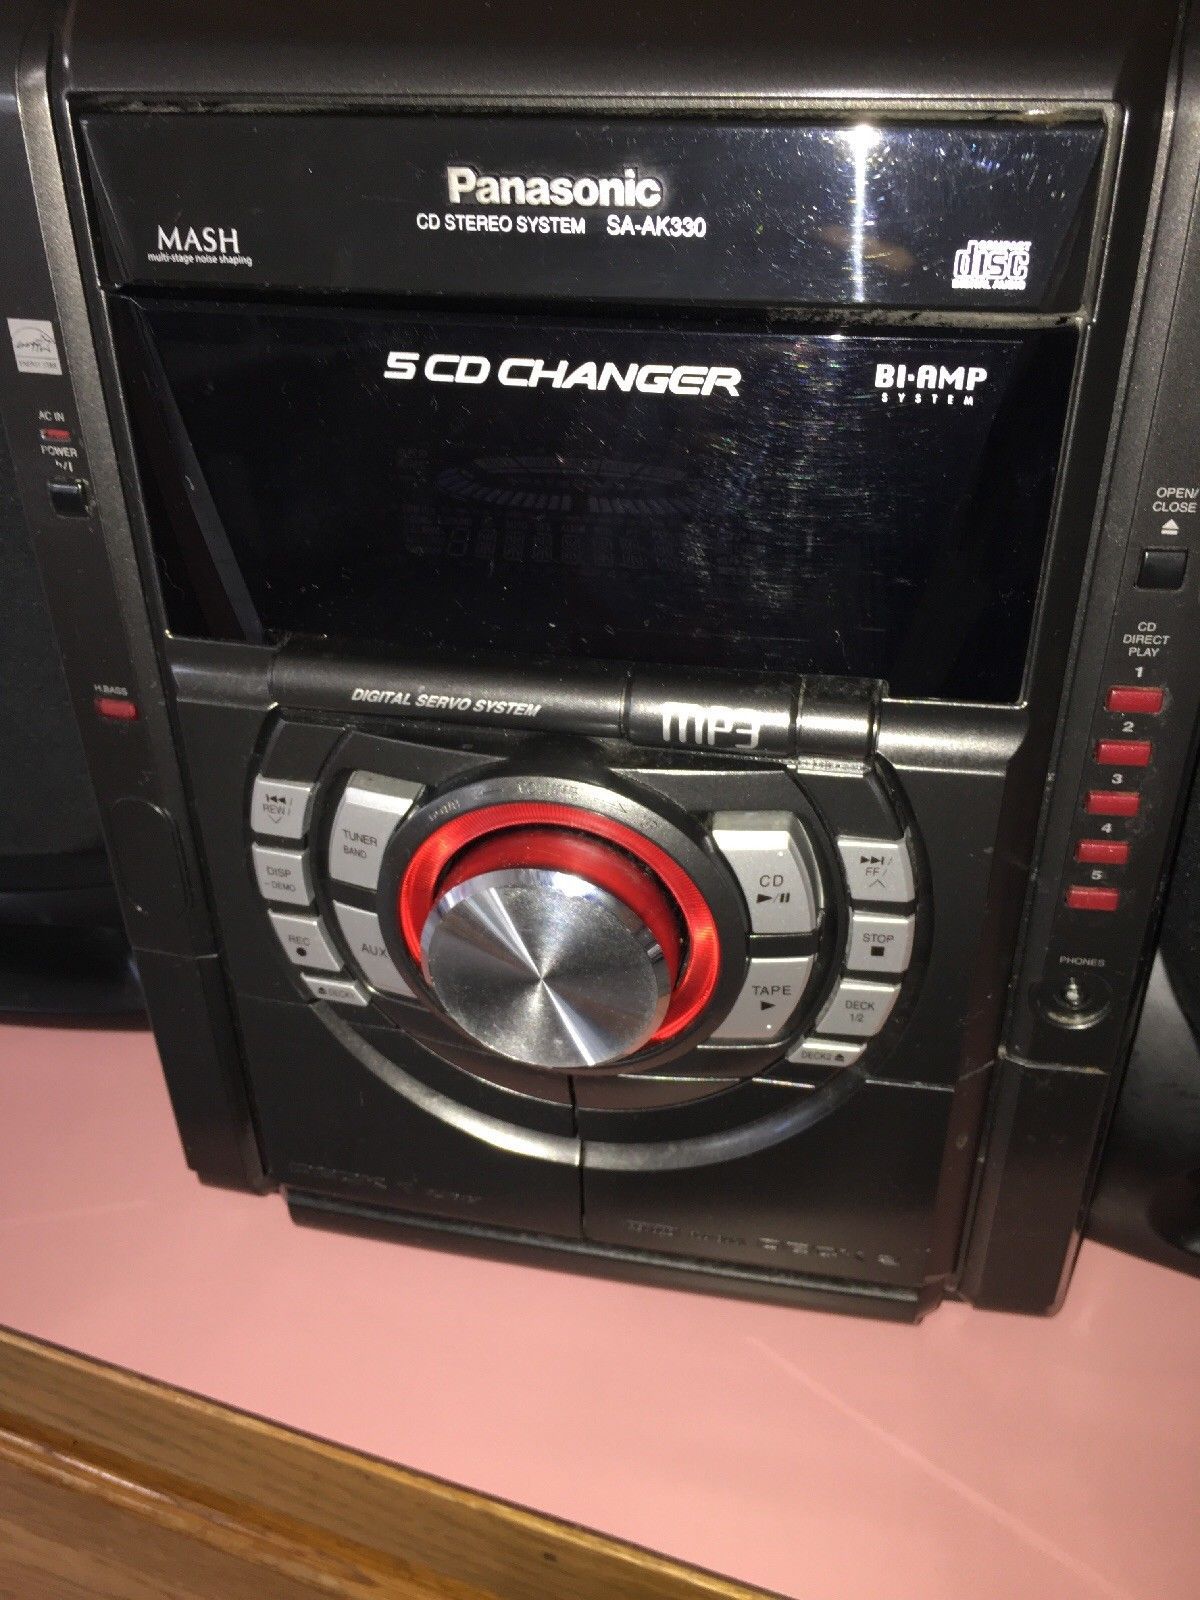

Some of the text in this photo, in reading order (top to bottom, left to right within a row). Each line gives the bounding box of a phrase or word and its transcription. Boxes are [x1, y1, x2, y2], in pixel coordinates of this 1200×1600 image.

[447, 165, 662, 208] Panasonic
[416, 213, 707, 238] CD STEREO SYSTEM SA-AK330
[158, 224, 240, 254] MASH
[147, 251, 253, 268] multi-stage noise shaping
[384, 351, 742, 397] 5 CD CHANGER
[881, 392, 974, 406] SYSTEM
[40, 444, 79, 458] POWER
[1152, 501, 1198, 513] CLOSE
[1137, 621, 1157, 632] CD
[1122, 634, 1171, 646] DIRECT
[1128, 647, 1161, 658] PLAY
[1134, 666, 1144, 678] 1
[352, 688, 542, 717] DIGITAL SERVO SYSTEM
[1121, 720, 1135, 733] 2
[1111, 773, 1124, 784] 3
[1100, 822, 1112, 833] 4
[342, 828, 378, 847] TUNER
[266, 866, 292, 879] DISP
[1091, 869, 1103, 881] 5
[759, 874, 784, 888] CD
[862, 932, 895, 944] STOP
[361, 943, 388, 958] AUX
[1059, 955, 1106, 968] PHONES
[752, 984, 792, 997] TAPE
[845, 1000, 875, 1012] DECK
